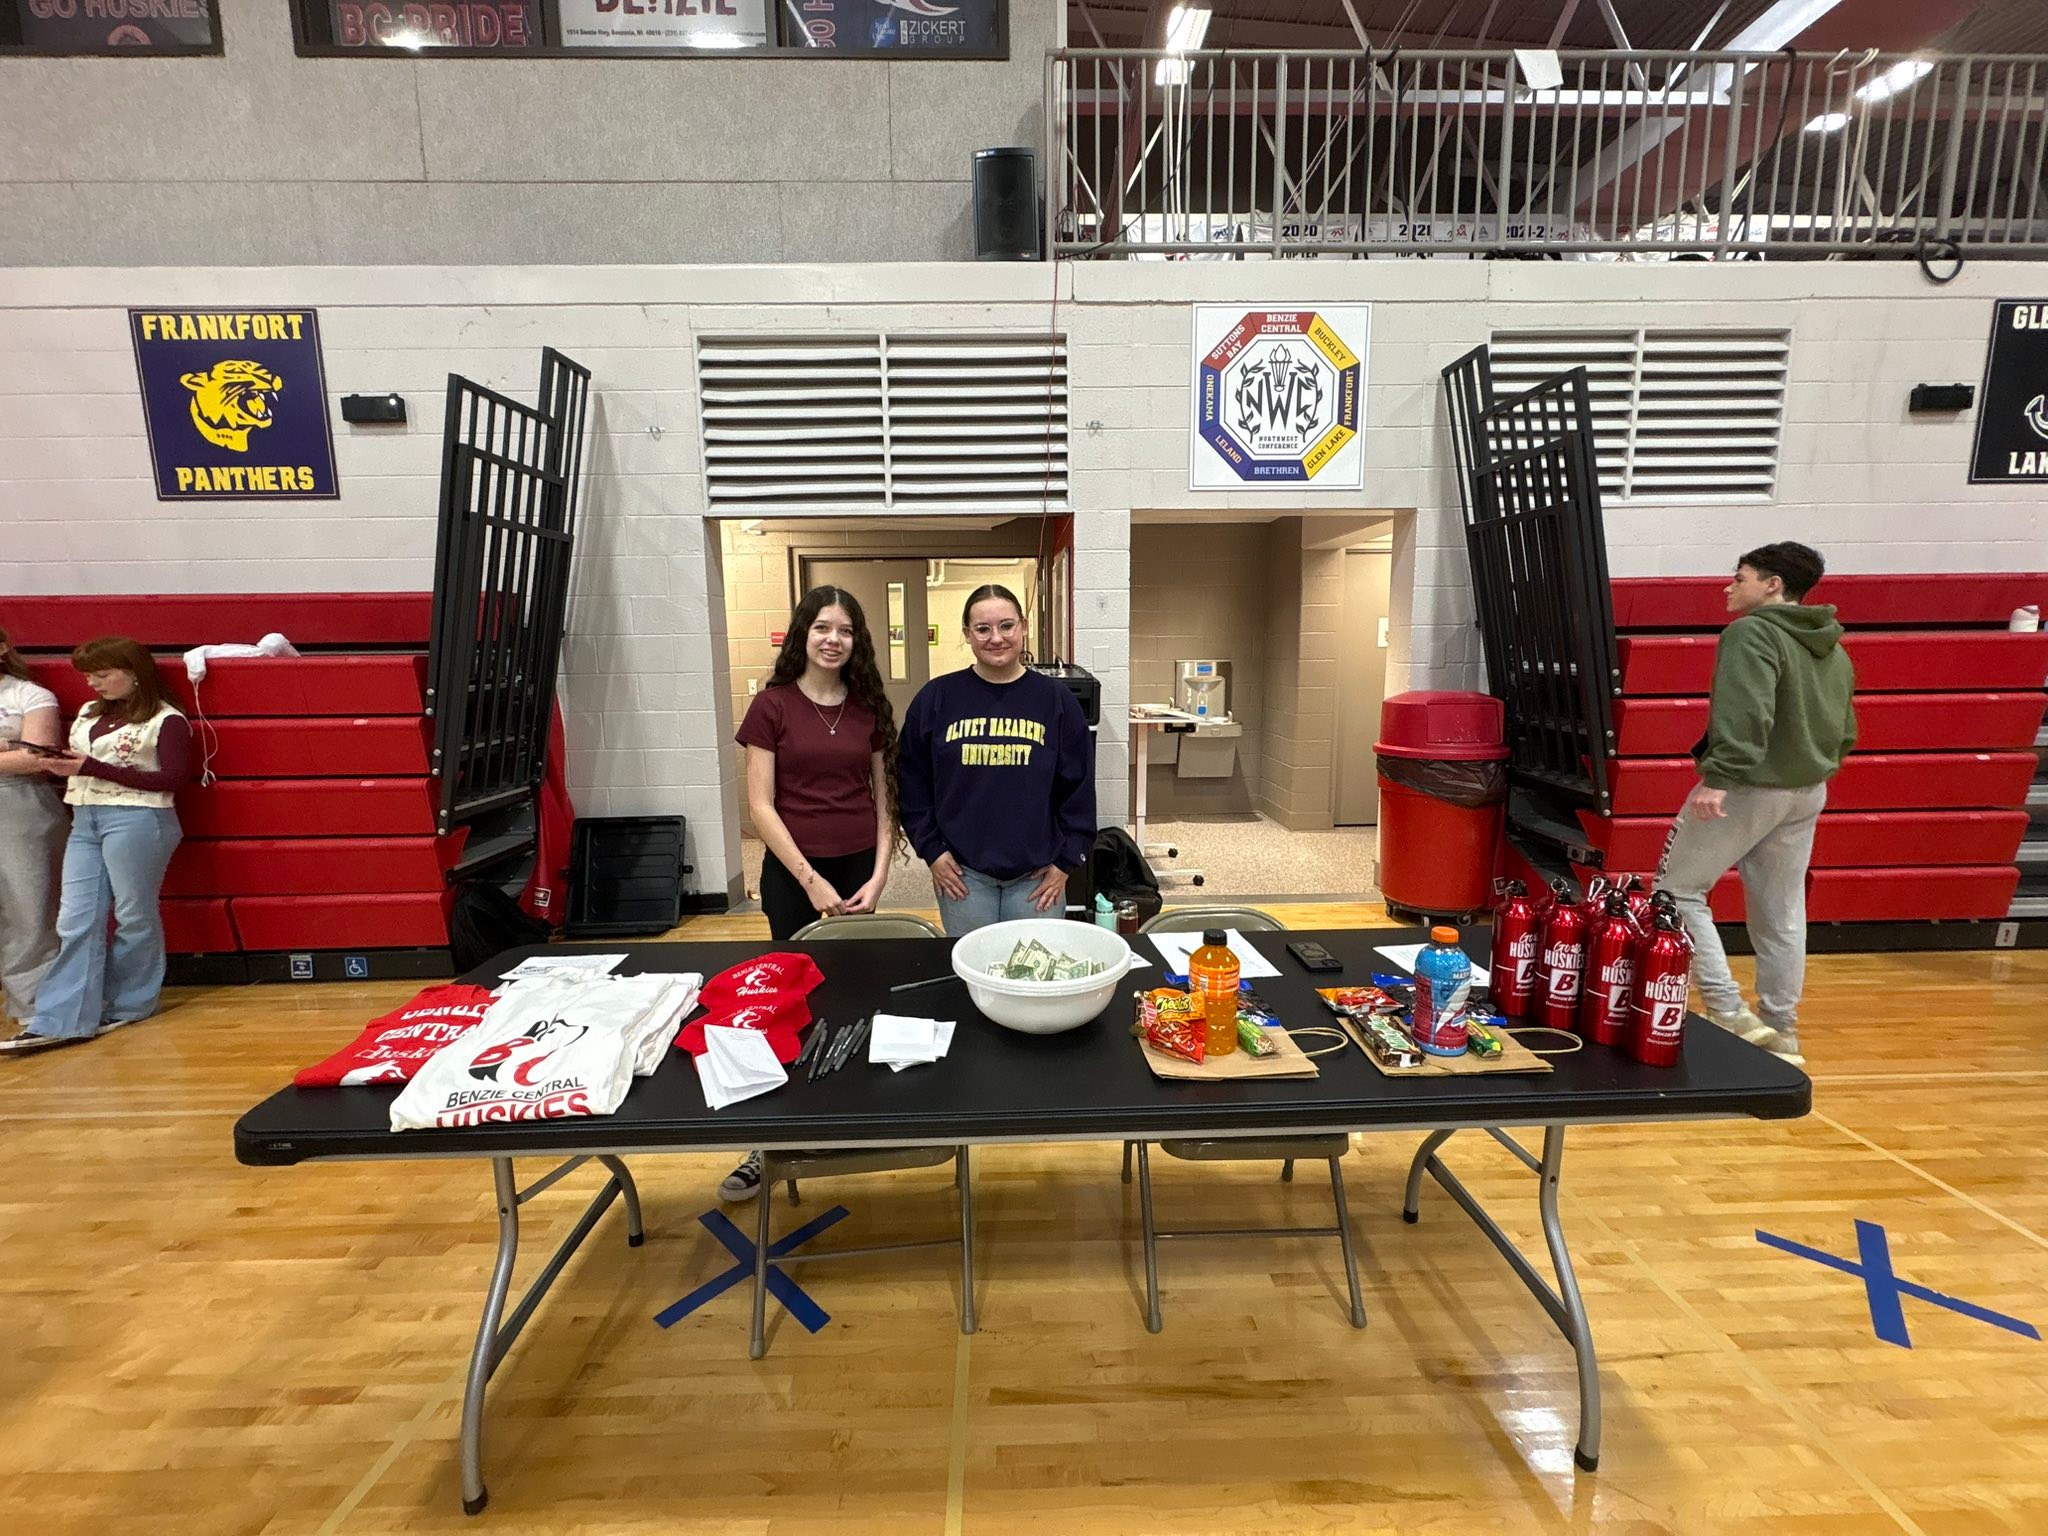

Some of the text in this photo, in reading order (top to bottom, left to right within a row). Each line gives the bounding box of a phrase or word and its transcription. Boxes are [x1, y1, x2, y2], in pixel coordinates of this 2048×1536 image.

[909, 20, 966, 35] ZICKERT
[909, 35, 965, 44] GROUP
[141, 314, 303, 340] FRANKFORT
[1266, 313, 1298, 323] BENZIE
[1260, 325, 1302, 333] CENTRAL
[1211, 324, 1246, 361] SUTTONS
[1227, 340, 1244, 360] BAY
[1314, 326, 1347, 362] BUCKLEY
[1205, 374, 1215, 421] ONEKAMA
[1343, 369, 1354, 426] FRANKFORT
[1215, 434, 1243, 464] LELAND
[1306, 429, 1346, 470] GLEN LAKE
[175, 466, 315, 491] PANTHERS
[1253, 466, 1300, 475] BRETHREN
[945, 717, 1047, 747] OLIVET NAZARENE
[961, 743, 1032, 766] UNIVERSITY
[1553, 940, 1571, 954] Go
[755, 962, 785, 976] CENTRAL
[1544, 948, 1585, 969] HUSKIES
[1554, 973, 1577, 992] B
[1656, 971, 1677, 986] Go
[735, 984, 779, 997] Huskies
[1155, 994, 1192, 1012] Cheetos
[1657, 1006, 1681, 1027] B
[446, 1076, 584, 1109] BENZIE CENTRAL
